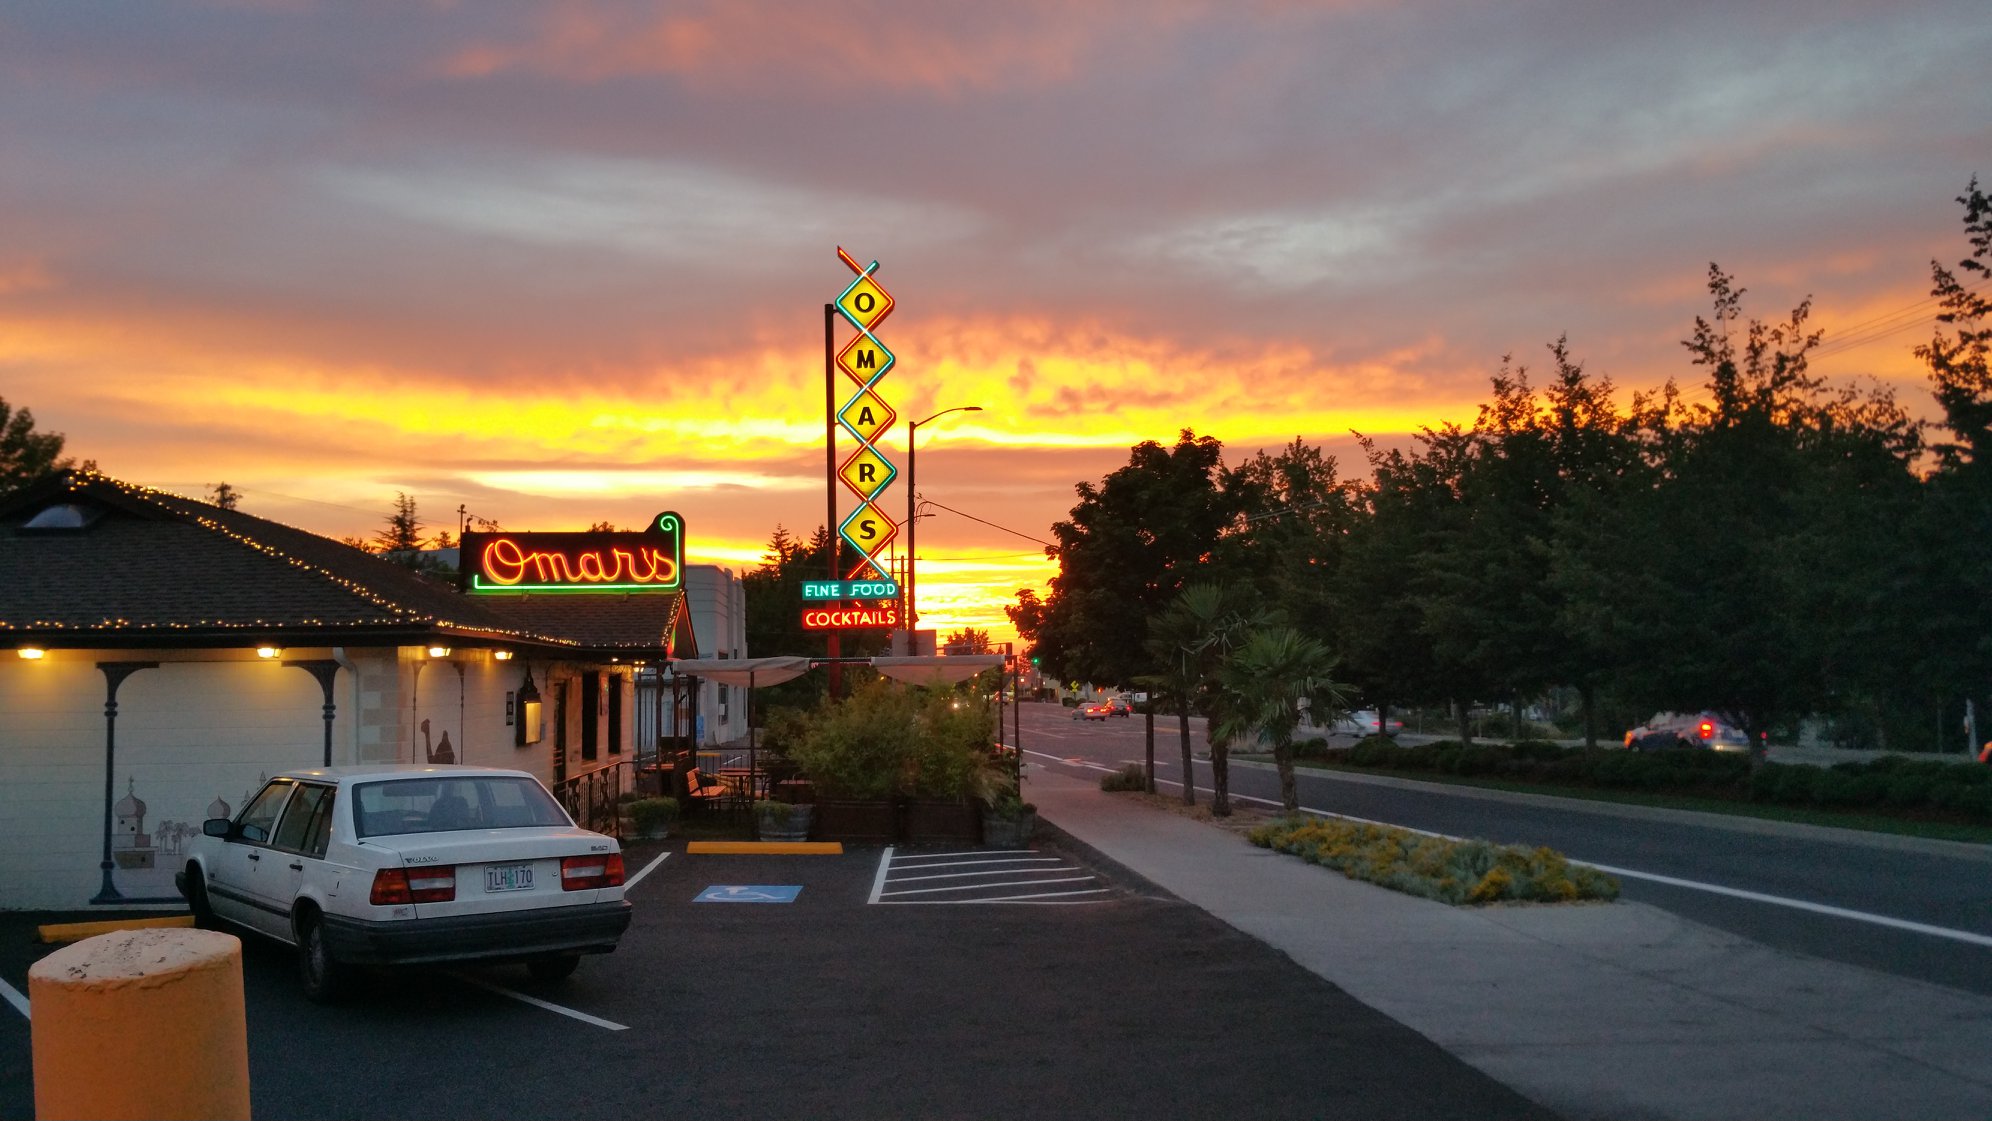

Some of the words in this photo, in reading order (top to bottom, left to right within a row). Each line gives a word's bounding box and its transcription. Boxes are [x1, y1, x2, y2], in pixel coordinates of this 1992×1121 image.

[854, 292, 876, 540] OMARS
[805, 584, 840, 597] FINE
[849, 583, 896, 596] FOOD
[805, 610, 896, 626] COCKTAILS
[488, 871, 507, 886] TLH
[515, 869, 532, 884] 170
